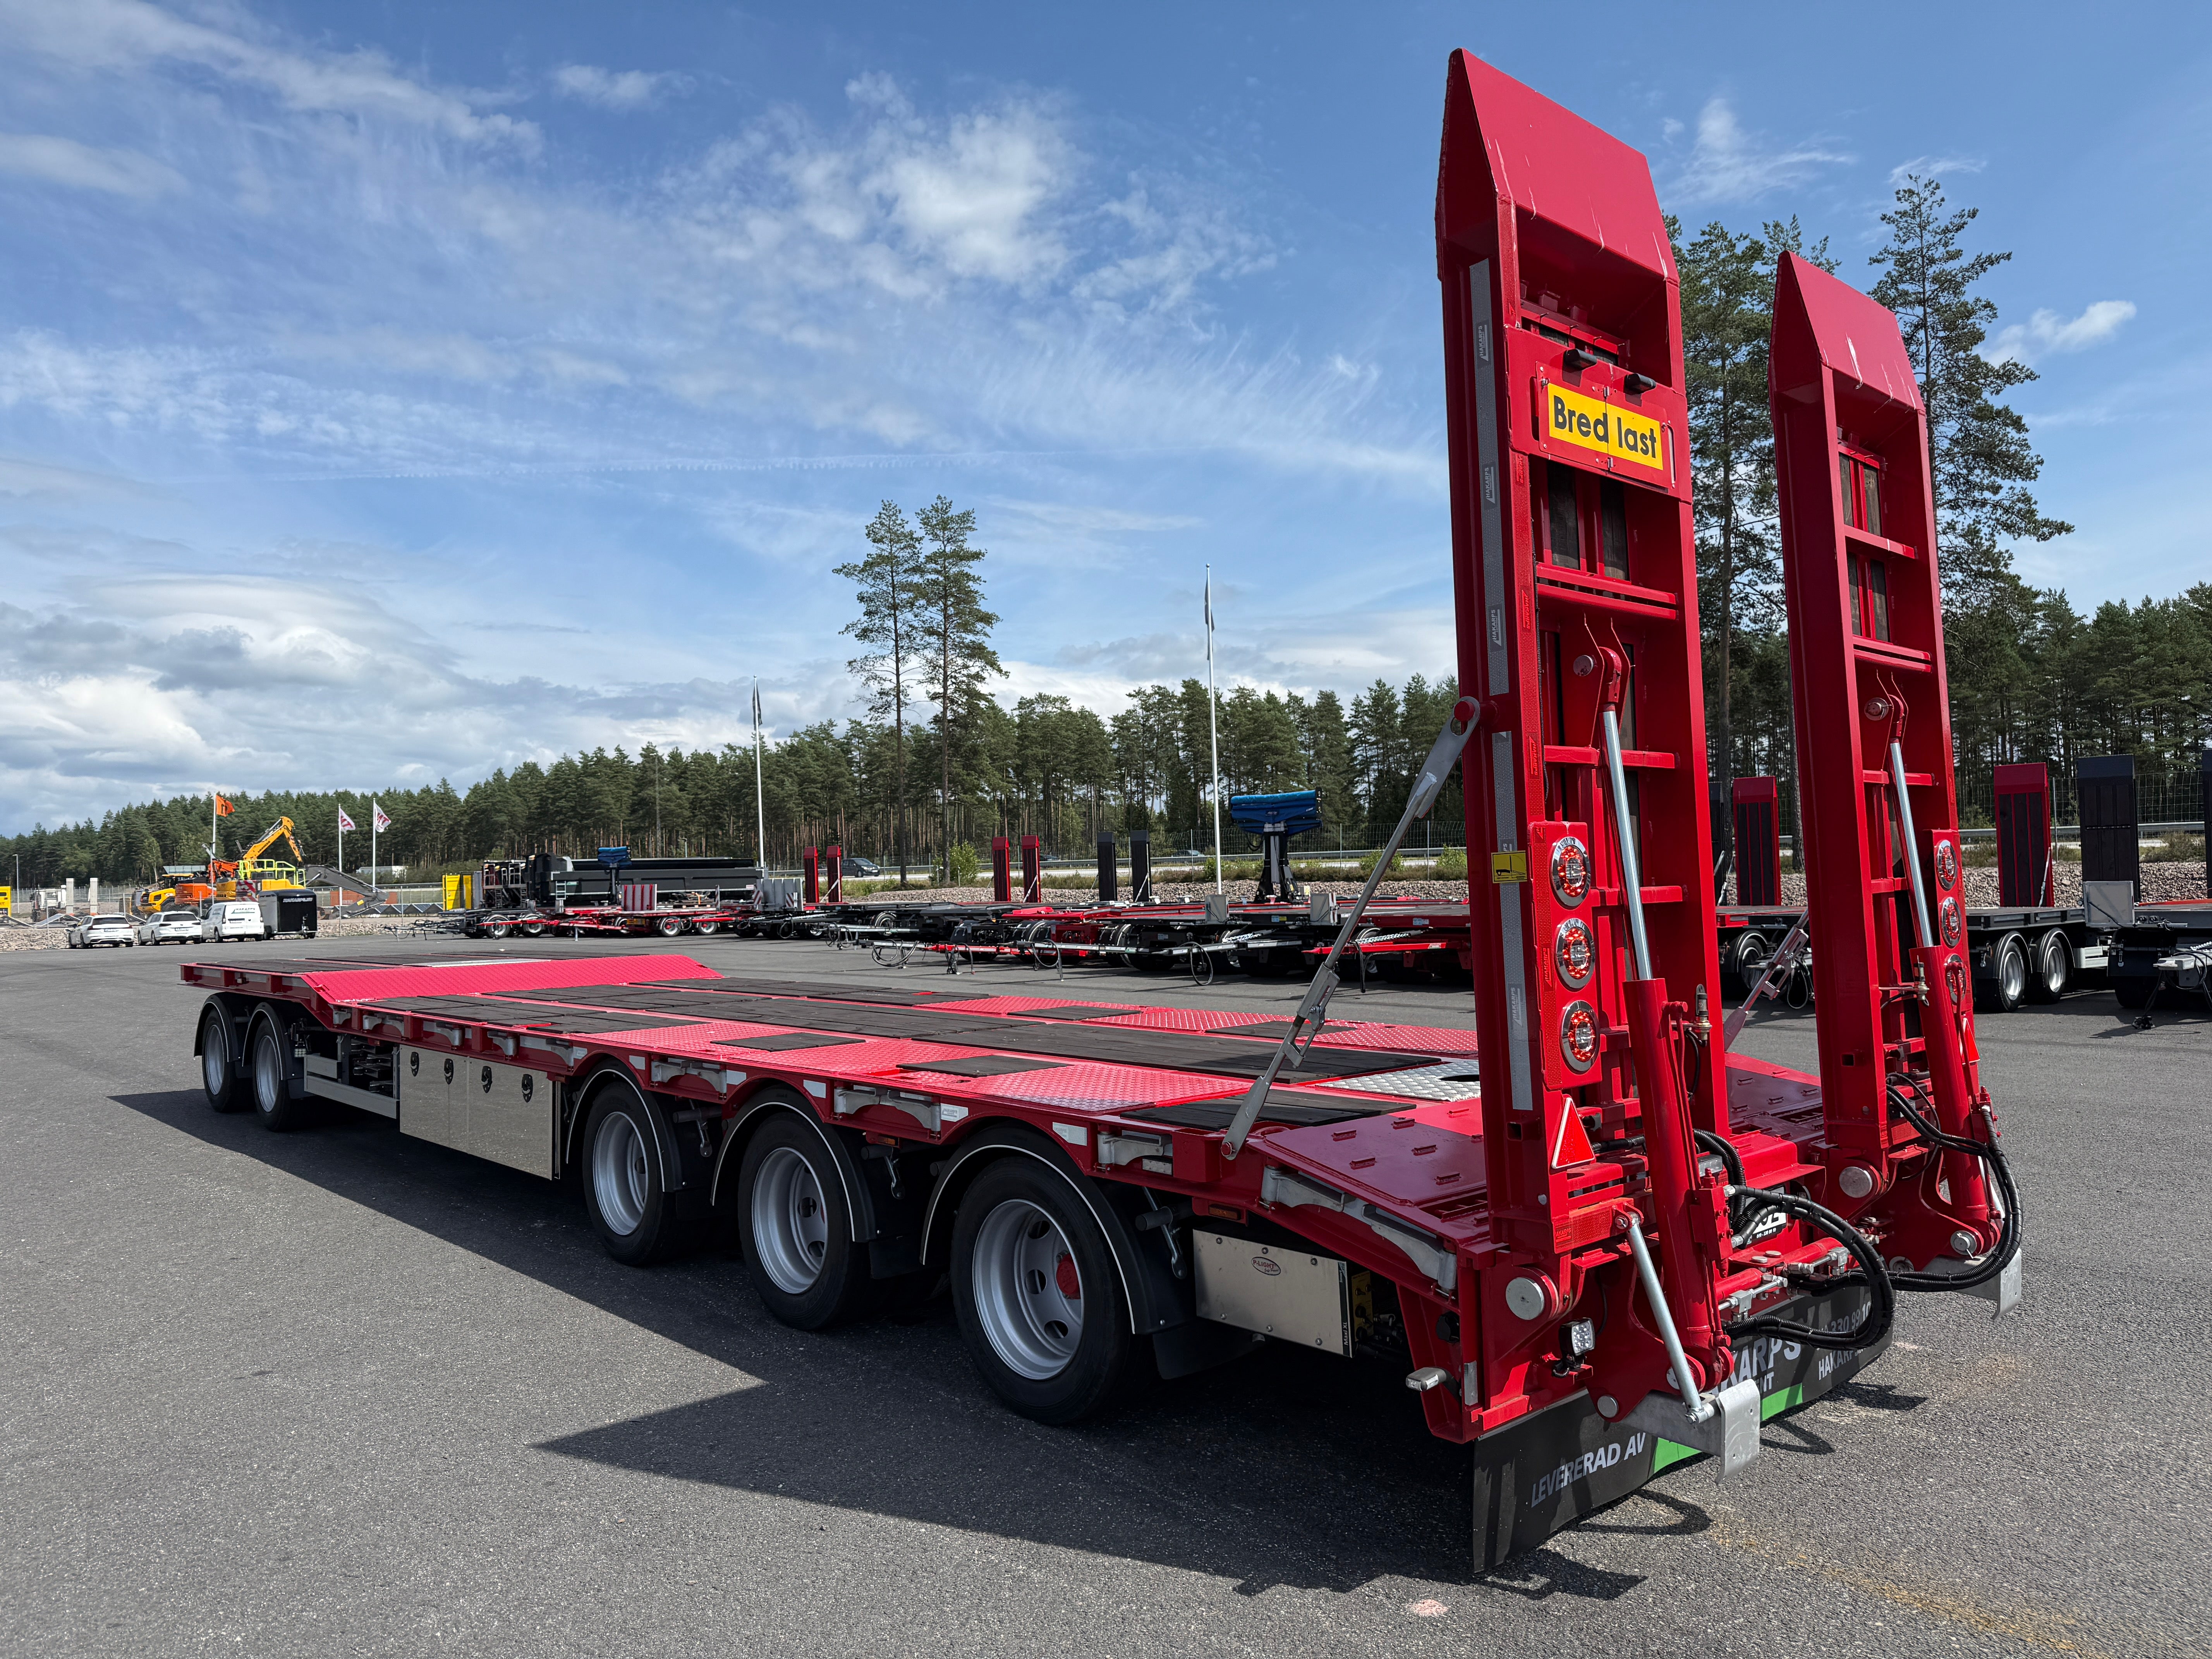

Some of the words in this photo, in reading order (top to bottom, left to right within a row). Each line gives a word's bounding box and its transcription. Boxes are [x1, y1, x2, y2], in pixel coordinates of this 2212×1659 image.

[1554, 395, 1609, 443] Bred
[1617, 417, 1656, 459] last
[1556, 1228, 1571, 1237] AKARPS
[1710, 1337, 1801, 1395] KARPS
[1531, 1443, 1621, 1508] LEVERERAD
[1624, 1432, 1646, 1460] AV
